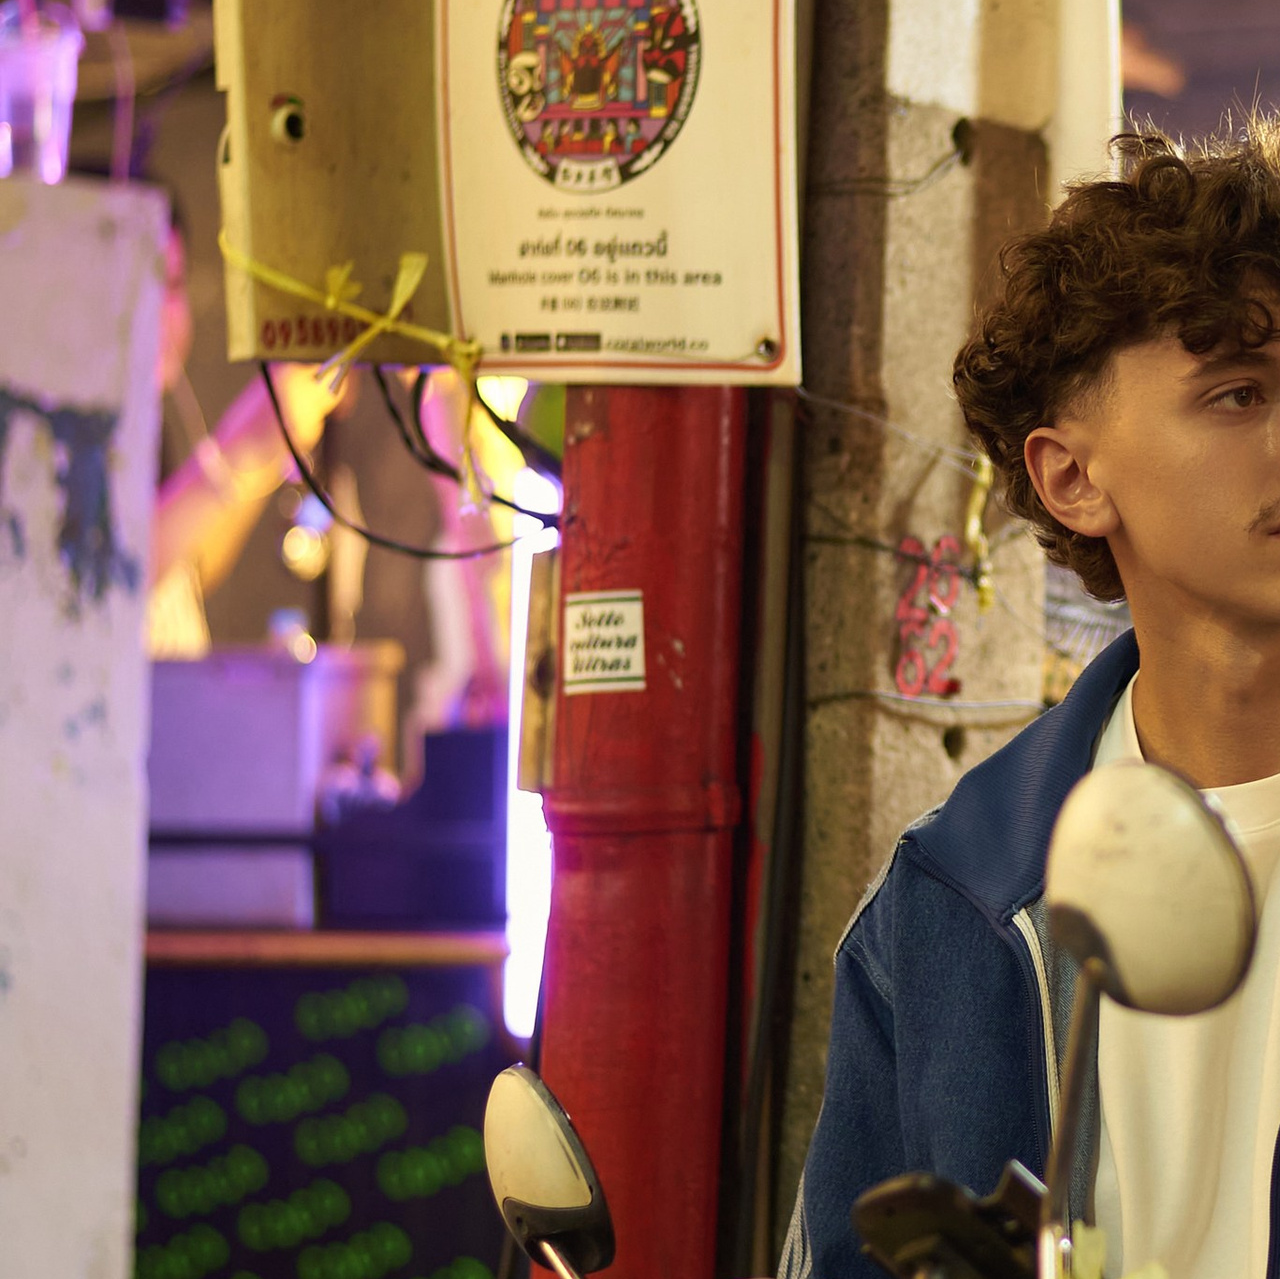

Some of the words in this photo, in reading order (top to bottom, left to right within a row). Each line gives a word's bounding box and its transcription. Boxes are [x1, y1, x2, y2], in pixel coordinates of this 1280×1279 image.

[541, 272, 573, 286] cover
[578, 269, 601, 286] 06
[606, 269, 618, 286] is
[625, 269, 640, 285] in
[645, 268, 677, 286] this
[683, 272, 723, 287] area
